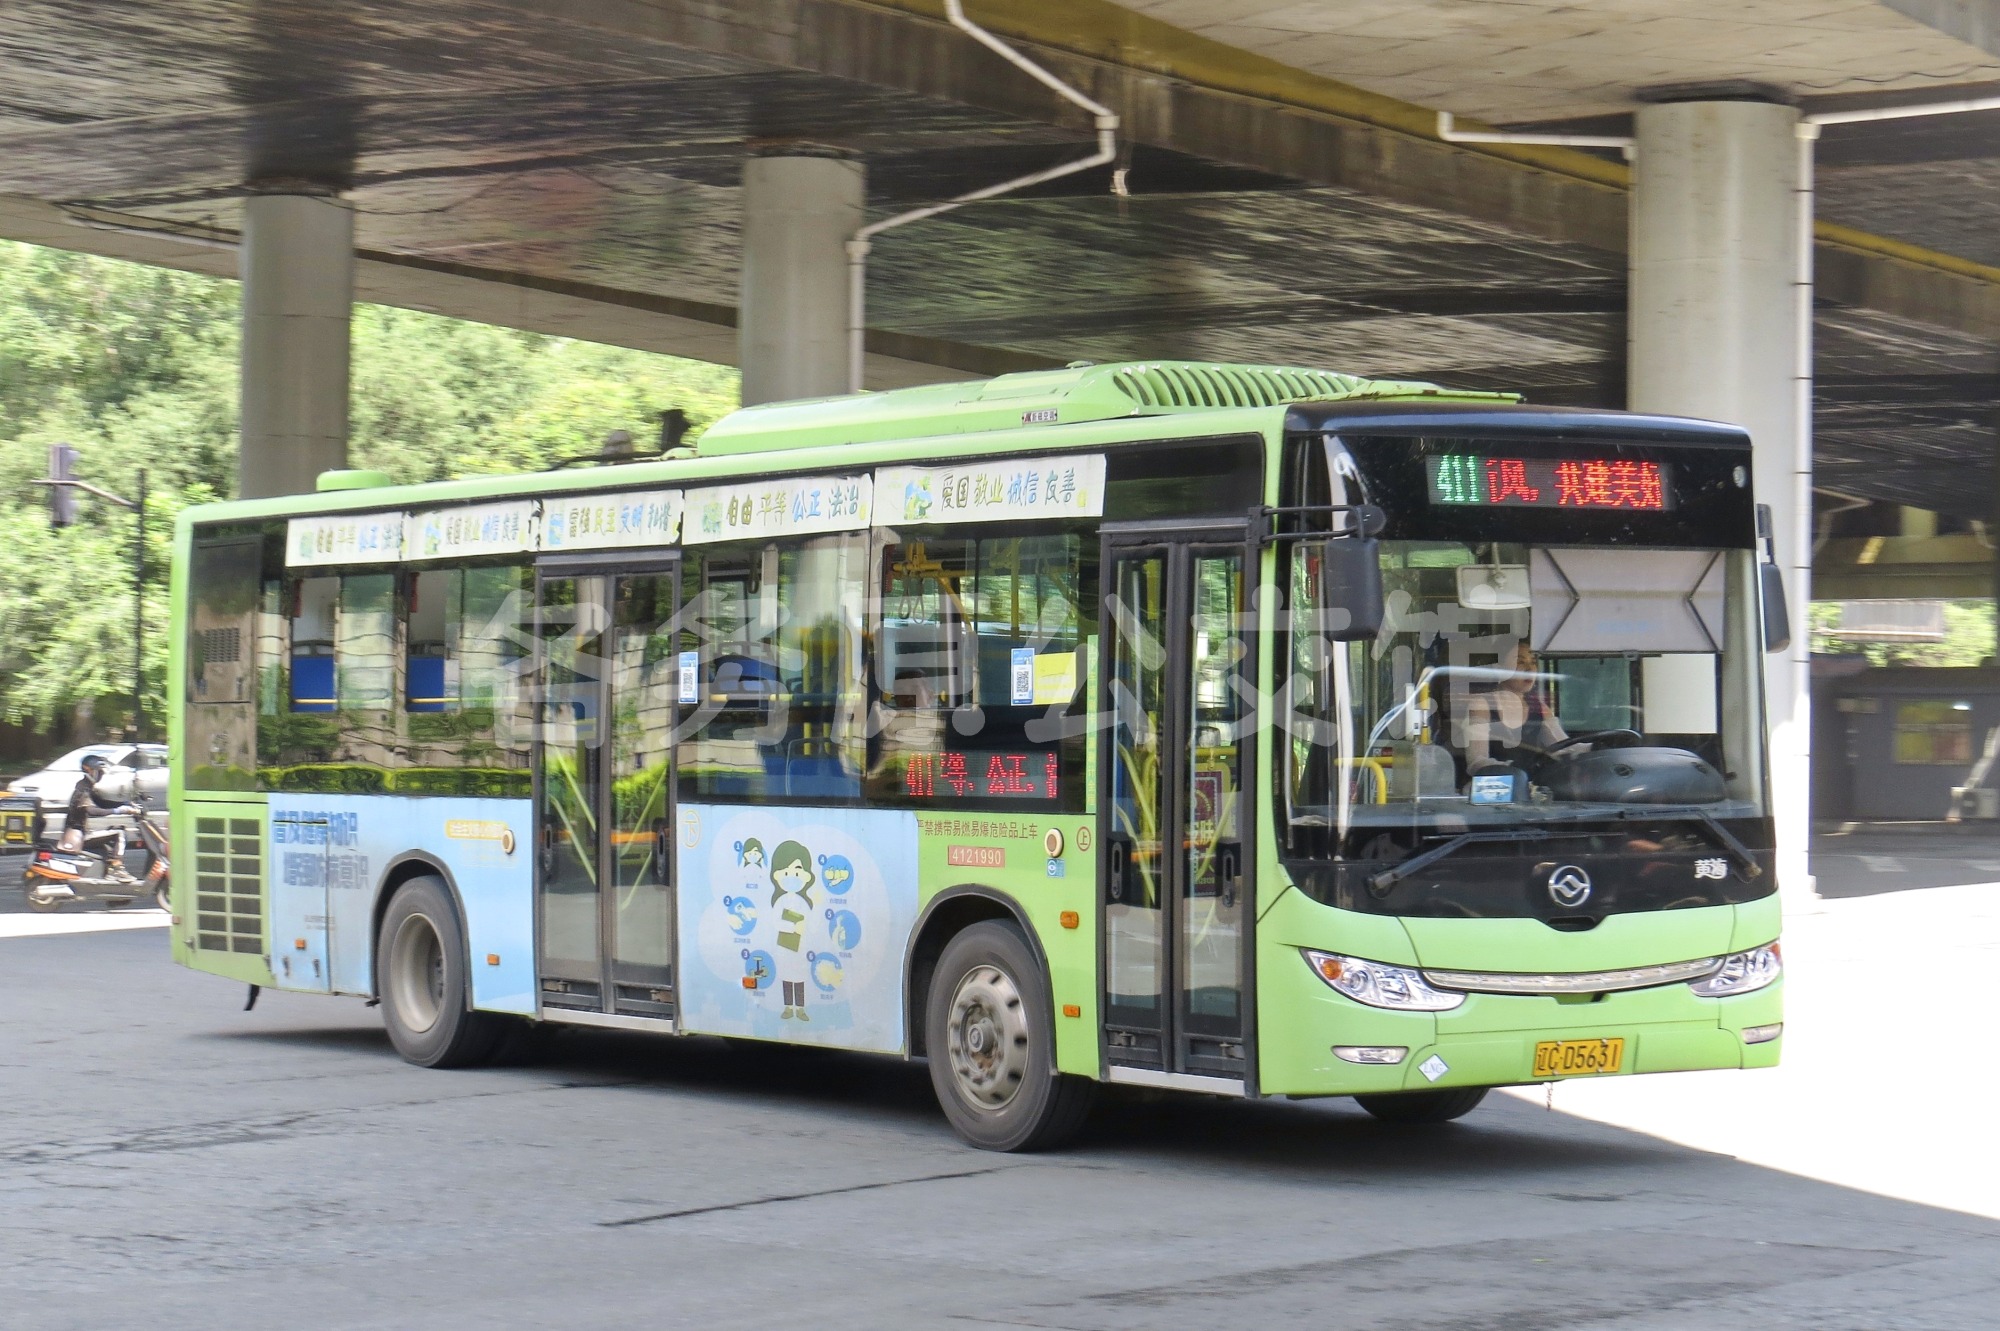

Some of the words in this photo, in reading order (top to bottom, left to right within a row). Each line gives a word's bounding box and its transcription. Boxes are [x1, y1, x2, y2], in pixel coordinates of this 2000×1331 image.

[1437, 455, 1480, 502] 411
[906, 753, 933, 796] 411
[952, 848, 1001, 865] 4121990
